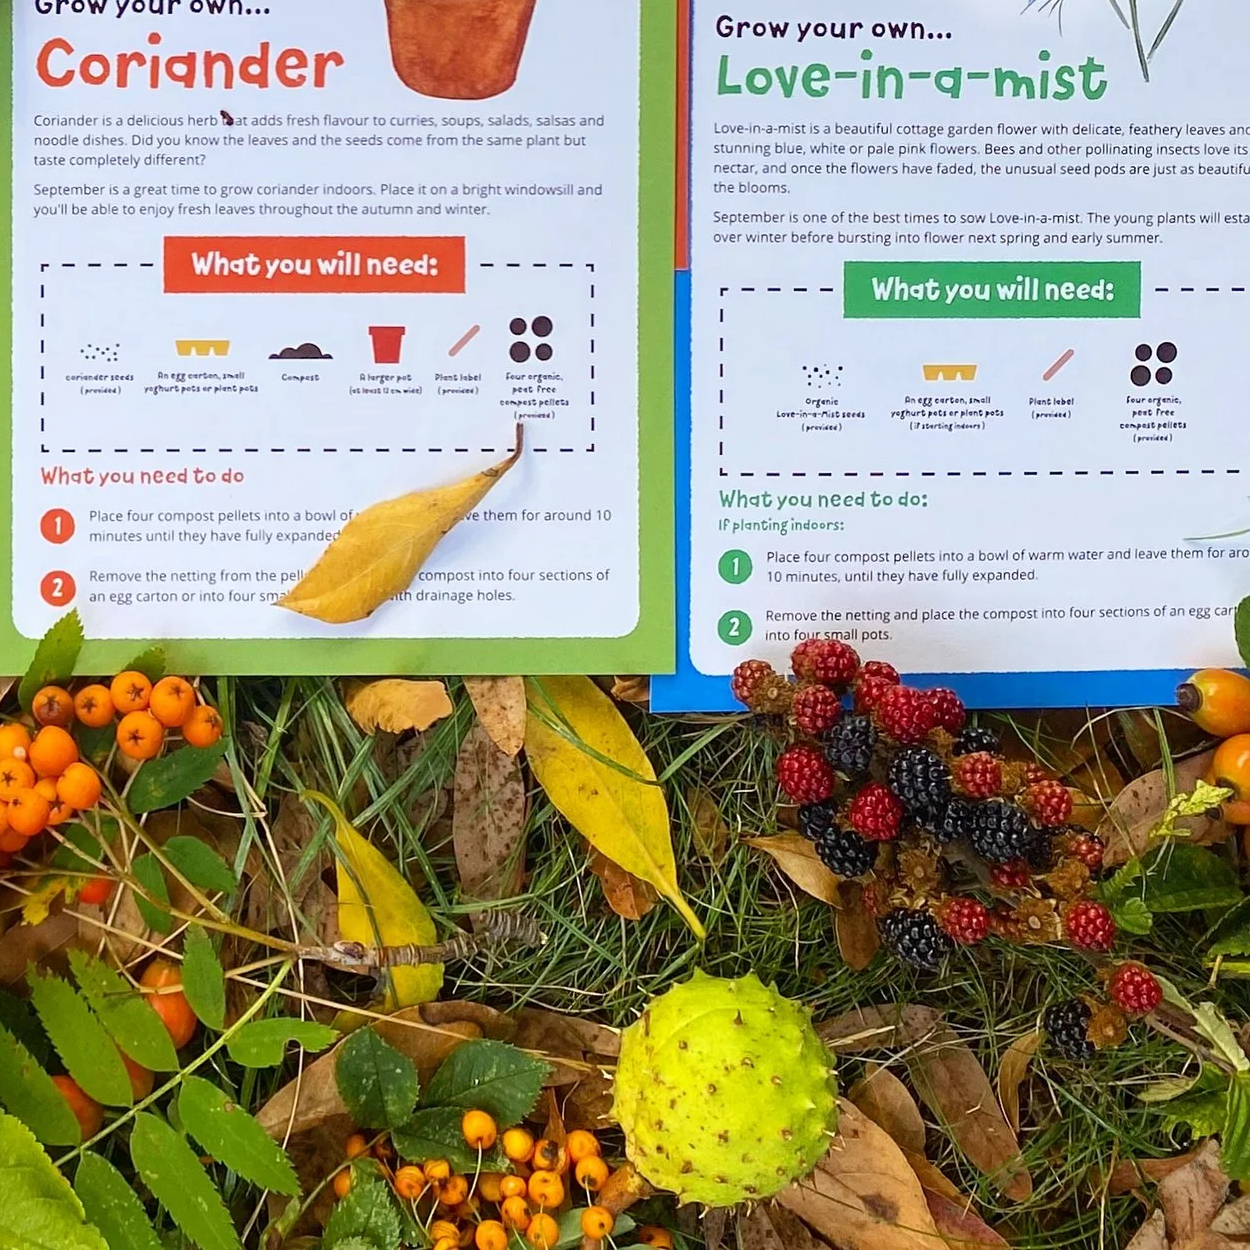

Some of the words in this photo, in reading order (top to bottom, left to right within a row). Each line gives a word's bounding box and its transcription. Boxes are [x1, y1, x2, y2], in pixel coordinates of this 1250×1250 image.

[716, 14, 790, 39] Grow
[797, 21, 864, 43] your
[871, 21, 952, 40] own...
[37, 33, 344, 89] Coriander
[718, 49, 1107, 100] Love-in-a-mist
[33, 155, 66, 166] taste
[69, 153, 141, 169] completely
[143, 153, 207, 166] different?
[713, 181, 735, 194] the
[738, 181, 791, 194] blooms.
[33, 203, 68, 219] you'll
[71, 203, 88, 216] be
[90, 203, 119, 216] able
[122, 205, 136, 215] to
[139, 205, 175, 219] enjoy
[177, 202, 211, 215] fresh
[214, 203, 256, 215] leaves
[258, 203, 334, 219] throughout
[336, 203, 359, 216] the
[361, 205, 413, 215] autumn
[416, 203, 442, 215] and
[444, 205, 491, 216] winter.
[713, 233, 743, 243] over
[745, 233, 788, 244] winter
[791, 230, 834, 244] before
[837, 231, 892, 247] bursting
[895, 232, 921, 244] into
[924, 231, 965, 244] flower
[968, 233, 997, 244] next
[999, 233, 1040, 247] spring
[1043, 231, 1068, 244] and
[1071, 231, 1103, 247] early
[1106, 234, 1163, 244] summer.
[191, 250, 261, 276] What
[265, 258, 312, 279] you
[317, 249, 361, 276] will
[366, 254, 438, 277] need:
[869, 277, 940, 304] What
[946, 275, 991, 304] you
[996, 275, 1039, 302] will
[1045, 276, 1115, 302] need:
[40, 465, 95, 485] What
[99, 471, 135, 488] you
[140, 467, 188, 485] need
[192, 467, 216, 485] to
[221, 467, 245, 484] do
[719, 489, 773, 509] What
[777, 495, 812, 511] you
[818, 491, 865, 508] need
[869, 490, 893, 508] to
[898, 491, 928, 508] do:
[54, 516, 62, 535] 1
[718, 517, 731, 531] If
[732, 517, 789, 536] planting
[790, 517, 845, 531] indoors:
[732, 557, 739, 576] 1
[766, 570, 782, 583] 10
[785, 572, 841, 584] minutes,
[844, 570, 873, 583] until
[877, 570, 905, 585] they
[908, 570, 939, 582] have
[942, 569, 969, 585] fully
[972, 568, 1039, 584] expanded.
[51, 577, 63, 598] 2
[728, 617, 741, 638] 2
